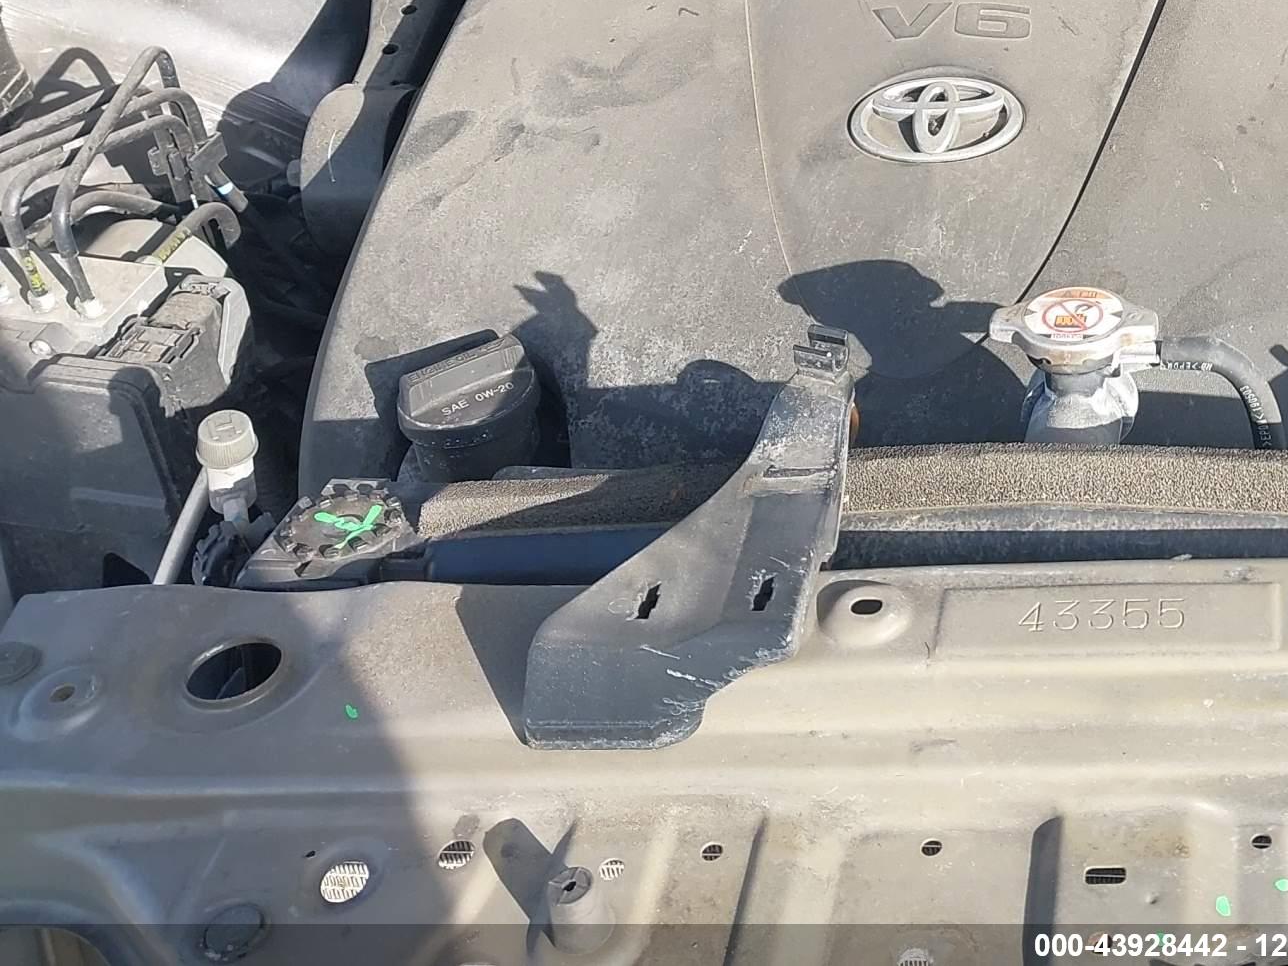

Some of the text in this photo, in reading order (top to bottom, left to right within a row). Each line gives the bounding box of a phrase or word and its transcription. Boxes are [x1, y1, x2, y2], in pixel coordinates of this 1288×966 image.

[872, 1, 1032, 40] V6
[441, 381, 514, 416] SAE 0W-20
[1018, 598, 1186, 632] 43355
